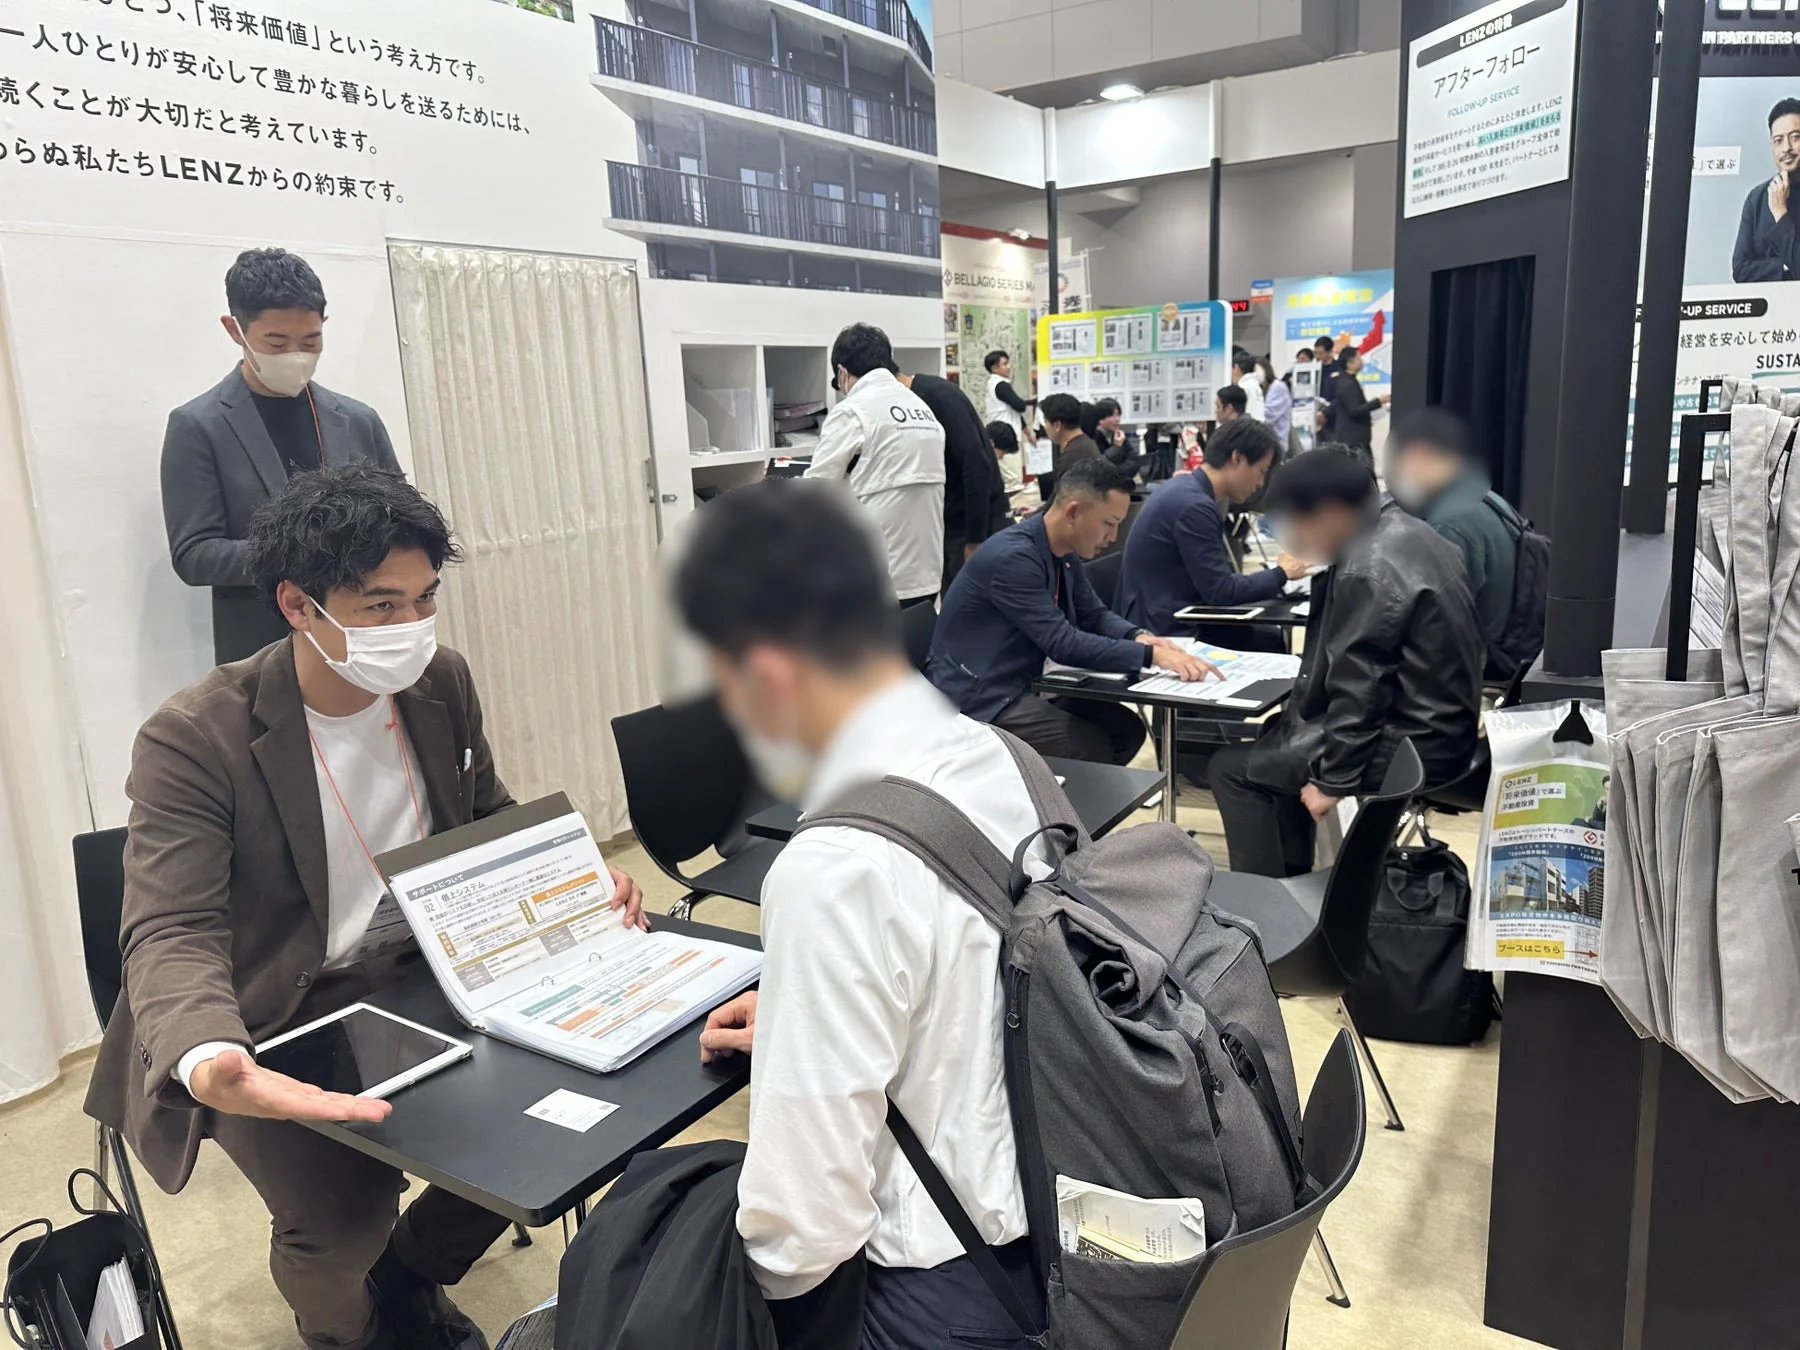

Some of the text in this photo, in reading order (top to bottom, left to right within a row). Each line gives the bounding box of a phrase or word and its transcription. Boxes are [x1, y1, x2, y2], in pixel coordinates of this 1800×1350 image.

[1717, 31, 1794, 45] PARTNERS
[0, 24, 530, 134] 一人ひとりが安心して豊かな暮らしを送るためには、
[1433, 45, 1541, 99] アフターフォロー
[1447, 85, 1521, 118] FOLLOW-UP SERVICE
[1692, 157, 1736, 171] 」で選ぶ
[954, 273, 996, 289] BELLAGIO
[997, 278, 1024, 290] SERIES
[1681, 303, 1752, 316] -UP SERVICE
[1680, 329, 1800, 348] 経営を安心して始め
[1756, 352, 1800, 369] SUSTA
[1513, 776, 1532, 786] LENZ
[412, 873, 465, 898] サポートについて
[424, 881, 486, 913] 02 借上システム
[1499, 943, 1561, 955] ブースはこちら
